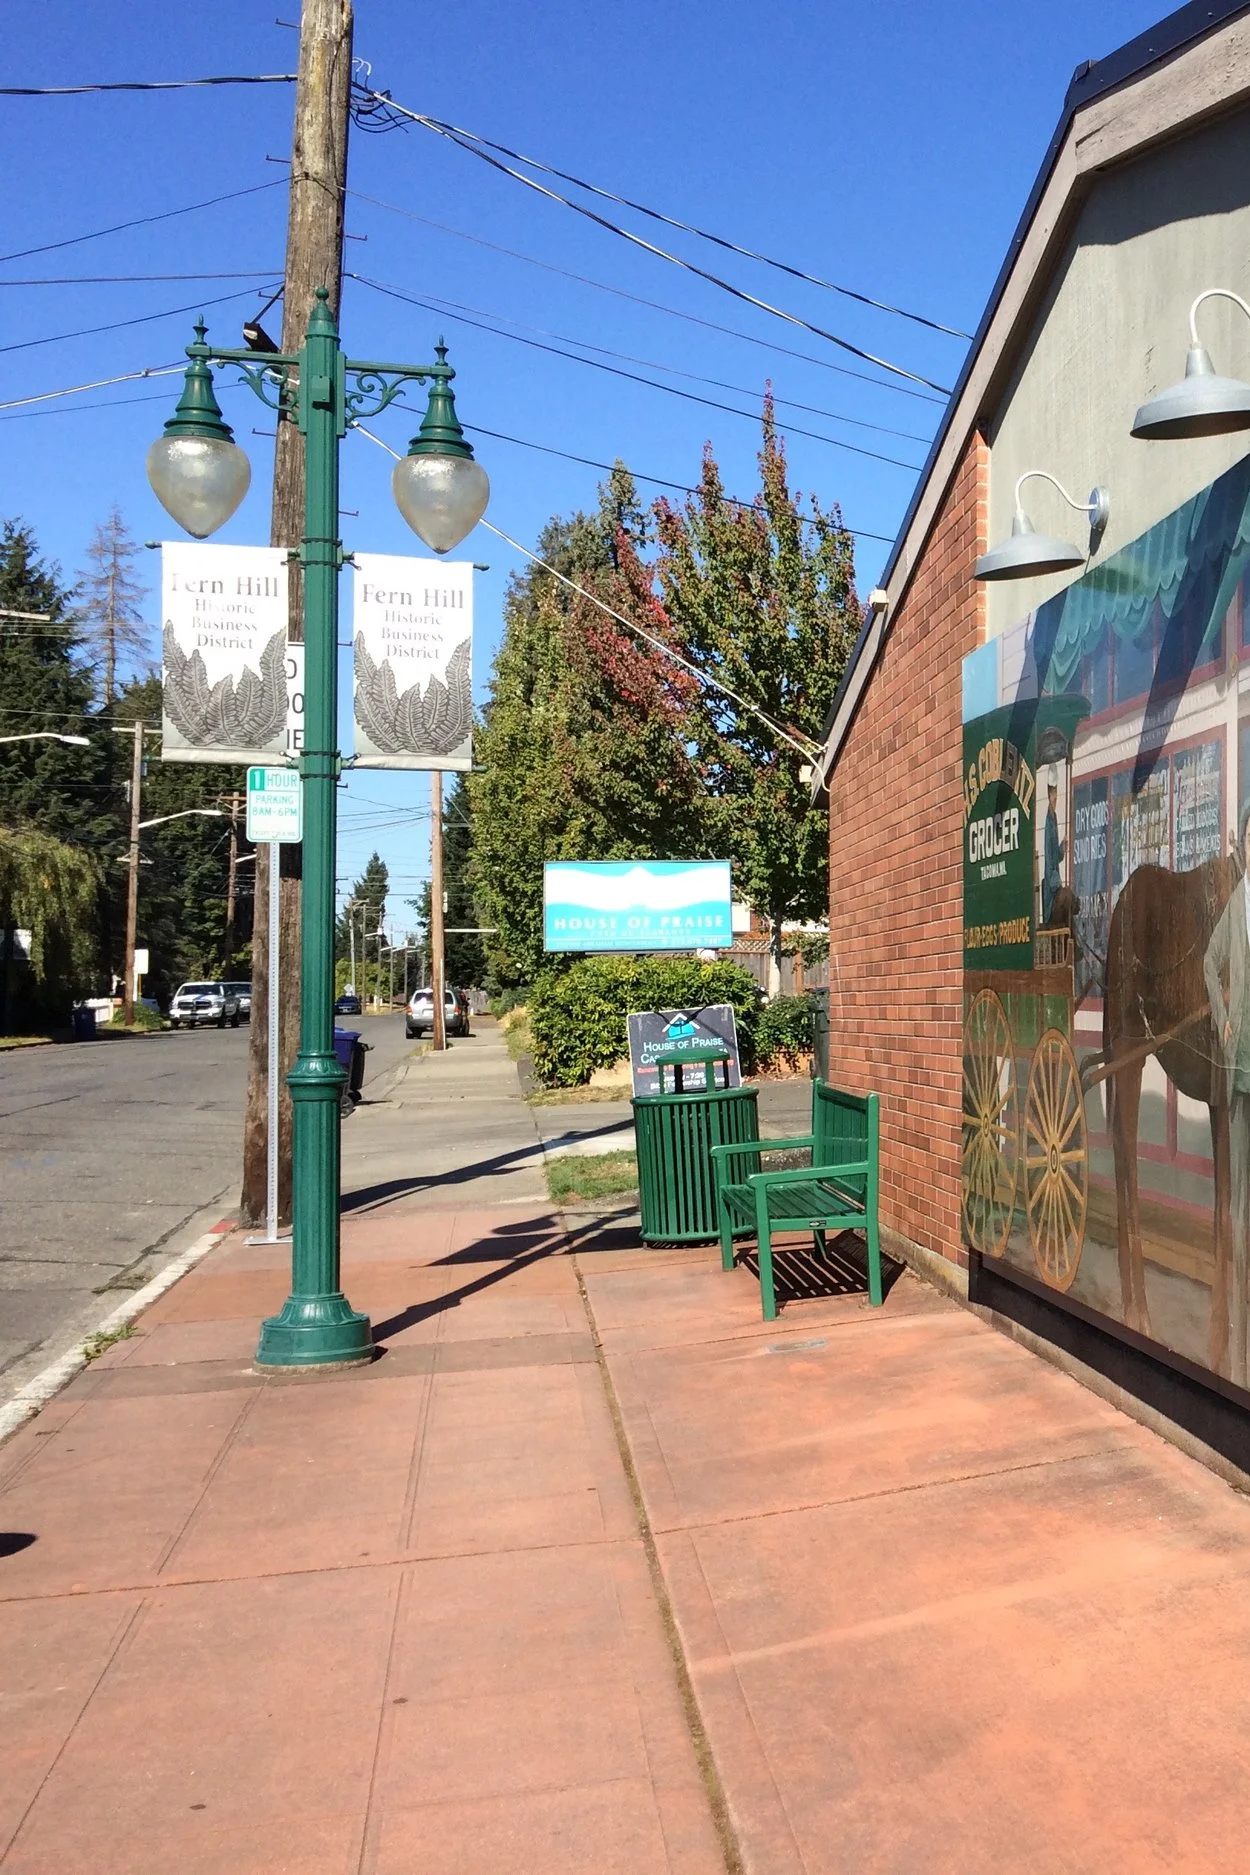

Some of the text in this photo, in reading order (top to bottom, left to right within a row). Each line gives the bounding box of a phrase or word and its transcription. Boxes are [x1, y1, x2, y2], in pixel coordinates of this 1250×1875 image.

[237, 576, 278, 597] Hill
[363, 584, 464, 609] Fern Hill
[192, 616, 258, 632] Business
[385, 610, 442, 625] Historic
[197, 633, 254, 650] District
[381, 627, 444, 642] Business
[386, 644, 440, 660] District
[254, 770, 298, 789] 1 HOUR
[255, 794, 294, 805] PARKING
[1075, 806, 1090, 833] DRY
[969, 807, 1020, 863] GROCER
[554, 914, 724, 930] HOUSE OF PRAISE
[643, 1041, 676, 1053] HOUSE
[691, 1037, 724, 1048] PRAISE
